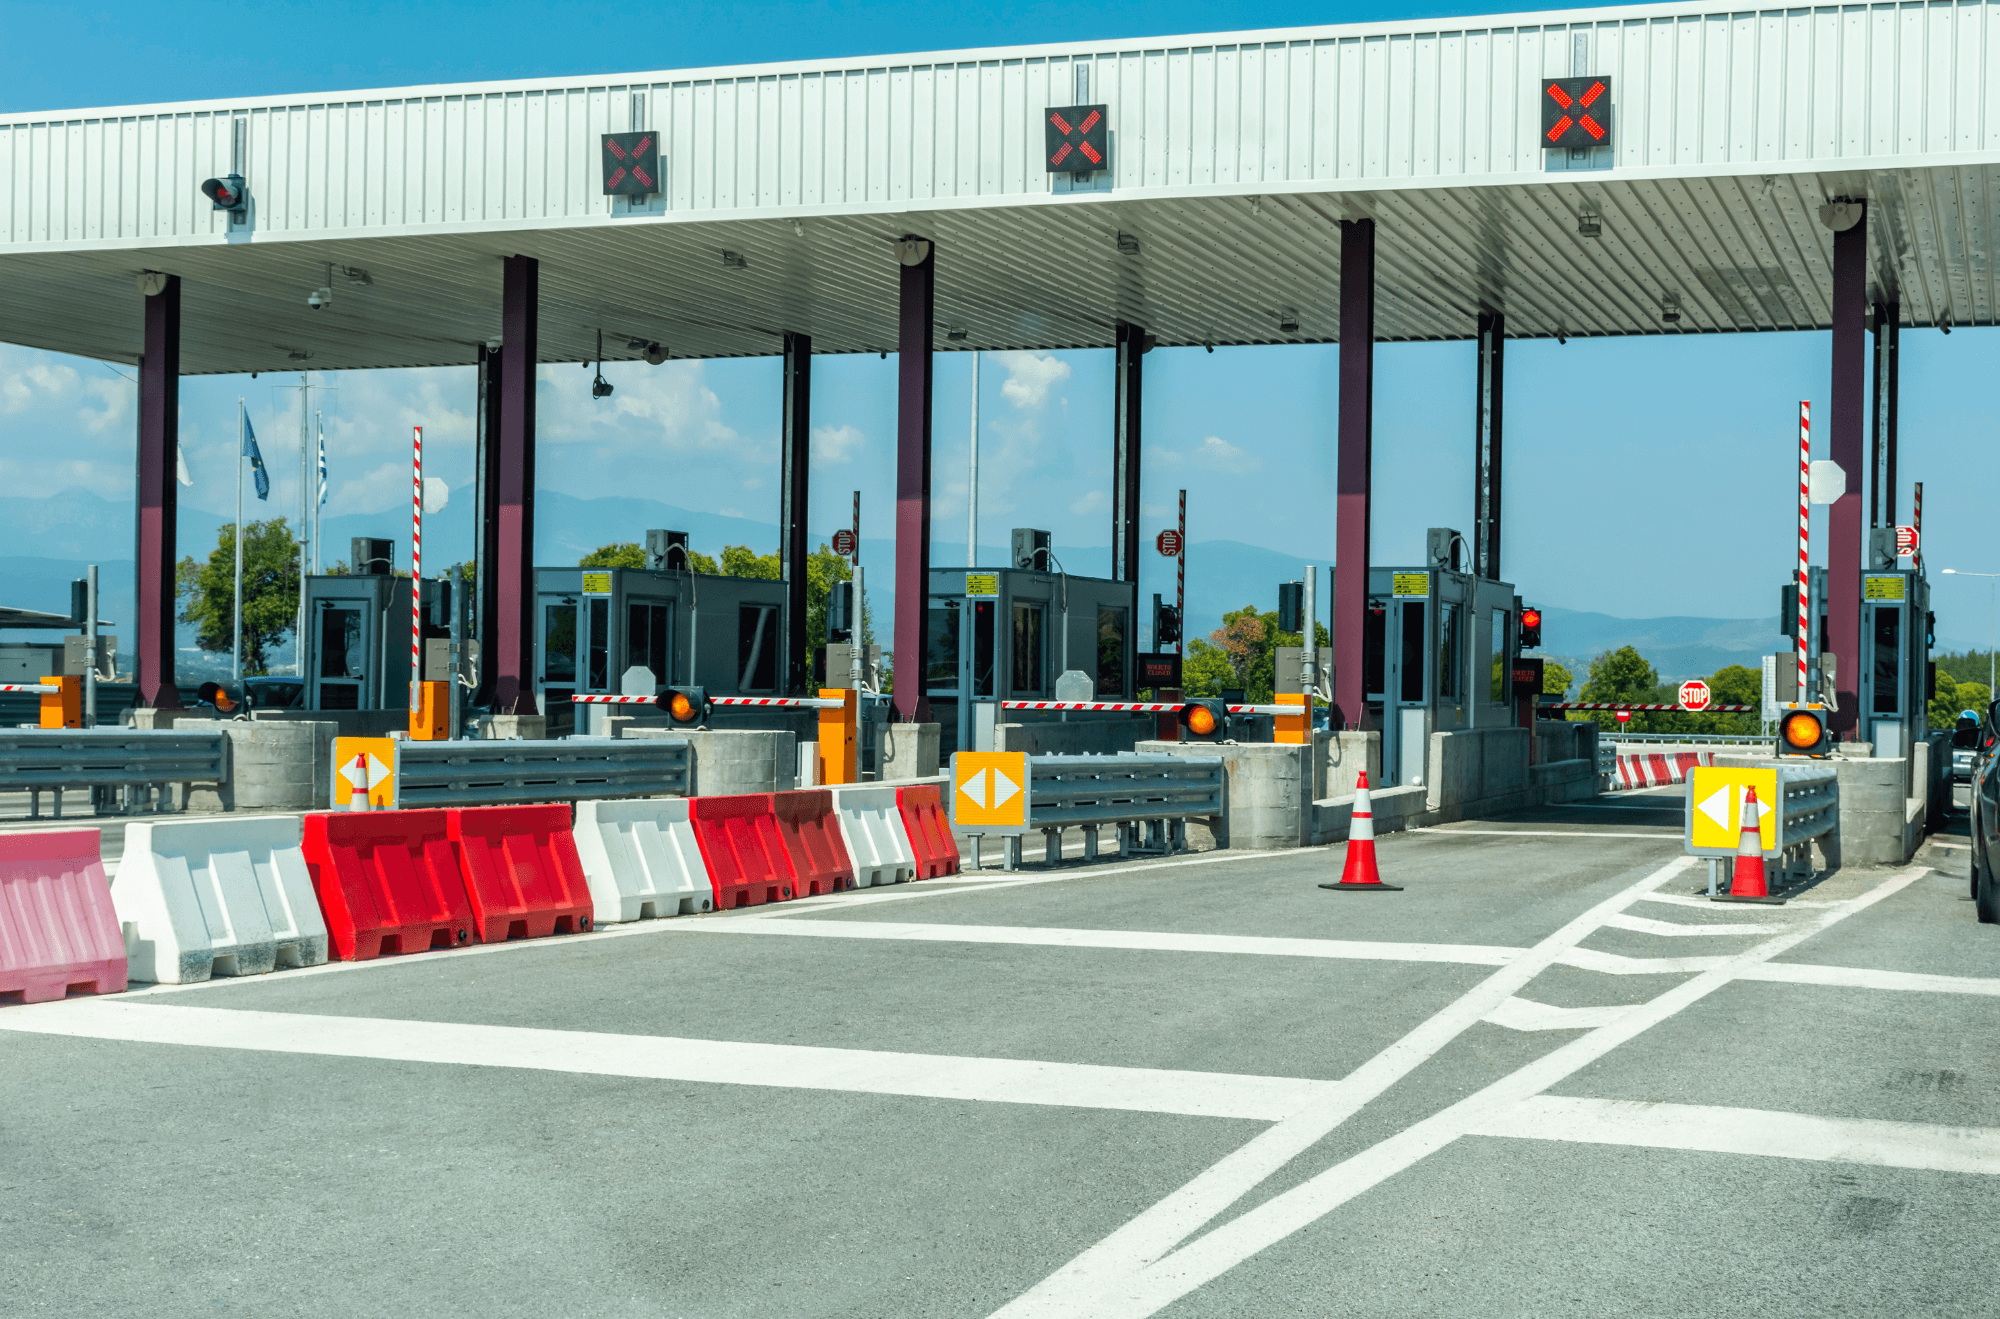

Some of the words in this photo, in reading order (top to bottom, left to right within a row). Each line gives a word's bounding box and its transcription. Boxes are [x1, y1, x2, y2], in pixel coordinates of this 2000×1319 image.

[838, 532, 851, 554] STOP
[1163, 531, 1177, 554] STOP
[1681, 688, 1708, 704] STOP
